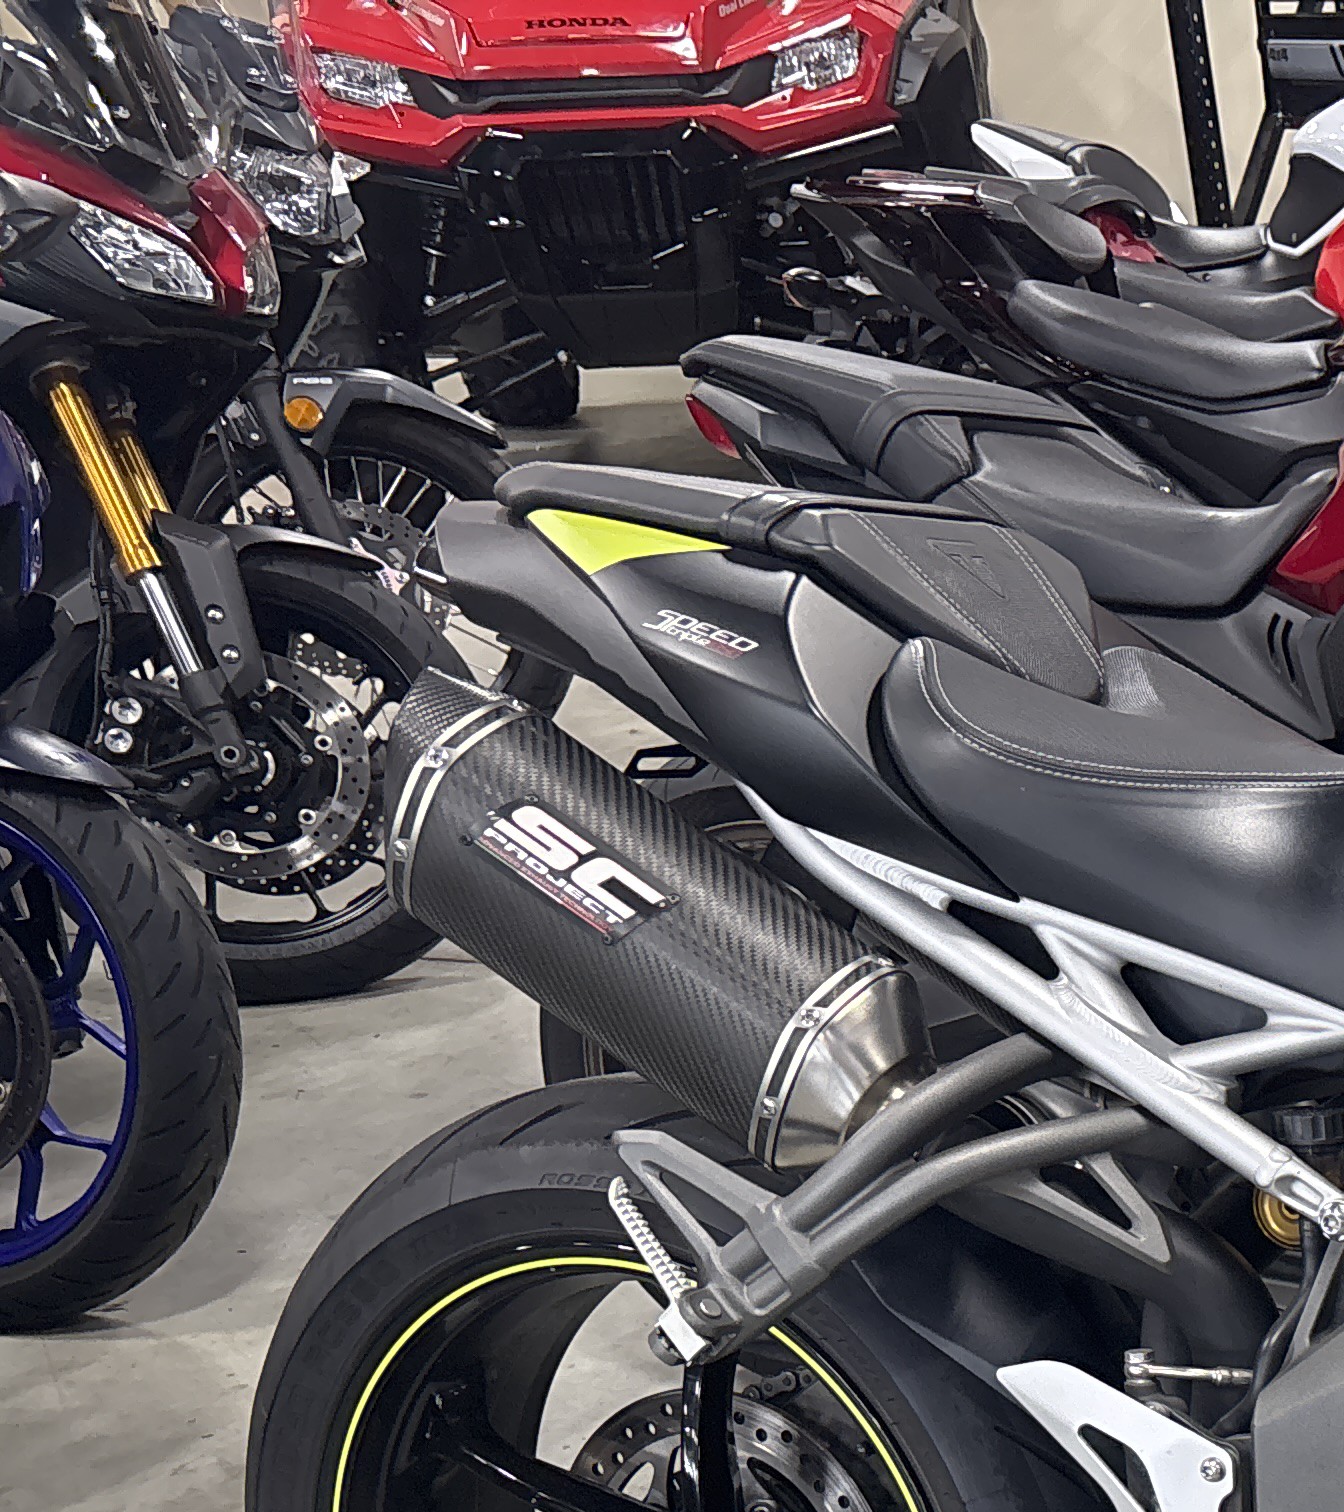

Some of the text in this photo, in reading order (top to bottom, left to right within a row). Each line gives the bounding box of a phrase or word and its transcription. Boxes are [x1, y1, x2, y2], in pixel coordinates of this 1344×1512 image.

[524, 16, 632, 30] HONDA
[641, 608, 760, 653] SPEED
[483, 826, 624, 925] PROJECT
[493, 804, 667, 920] SC
